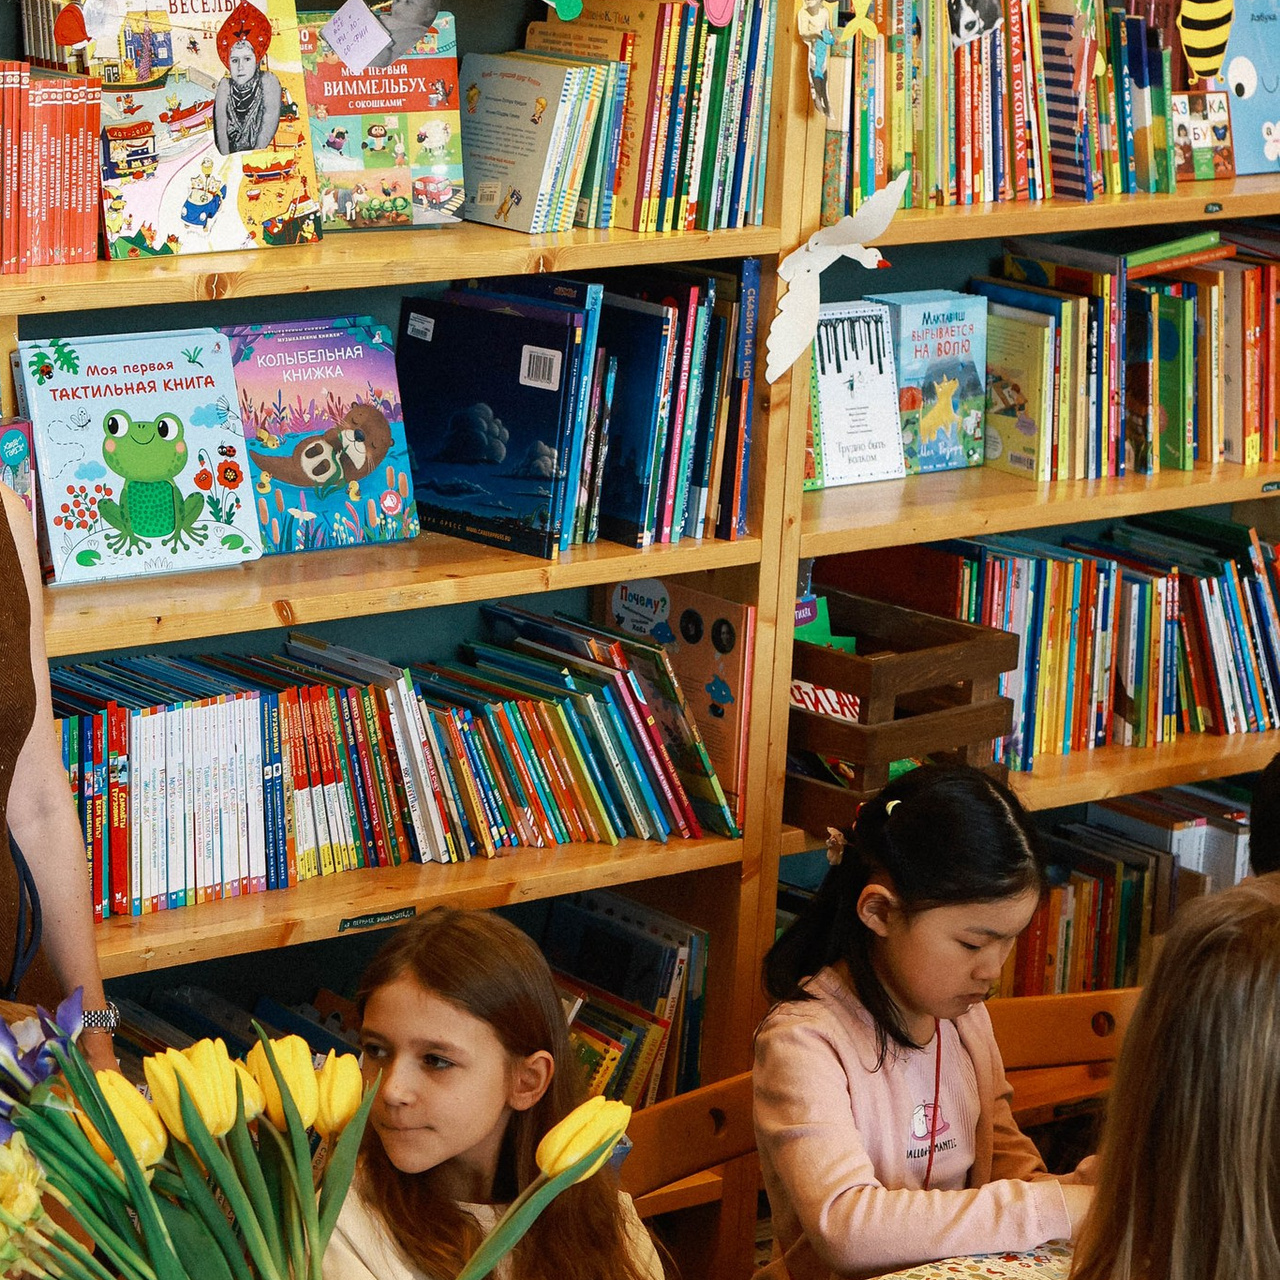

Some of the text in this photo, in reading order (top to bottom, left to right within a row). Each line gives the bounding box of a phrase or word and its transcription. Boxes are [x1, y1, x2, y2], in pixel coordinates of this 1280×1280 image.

[682, 26, 695, 85] МЫШОНОК ТИМ
[695, 24, 708, 83] МЫШОНОК ТИМ
[1012, 64, 1022, 73] В
[324, 77, 427, 96] ВИММЕЛЬБУХ
[1121, 65, 1134, 140] АЗБУКА
[1013, 79, 1026, 160] ОКОШКАХ
[911, 323, 974, 340] ВЫРЫВАЕТСЯ
[257, 345, 364, 368] КОЛЫБЕЛЬНАЯ
[914, 339, 971, 359] НА ВОЛЮ
[86, 361, 174, 378] Моя первая
[282, 364, 344, 383] КНИЖКА
[49, 374, 215, 402] ТАКТИЛЬНАЯ КНИГА
[620, 585, 667, 615] Почему?
[272, 709, 280, 753] ГРУЗОВИКИ
